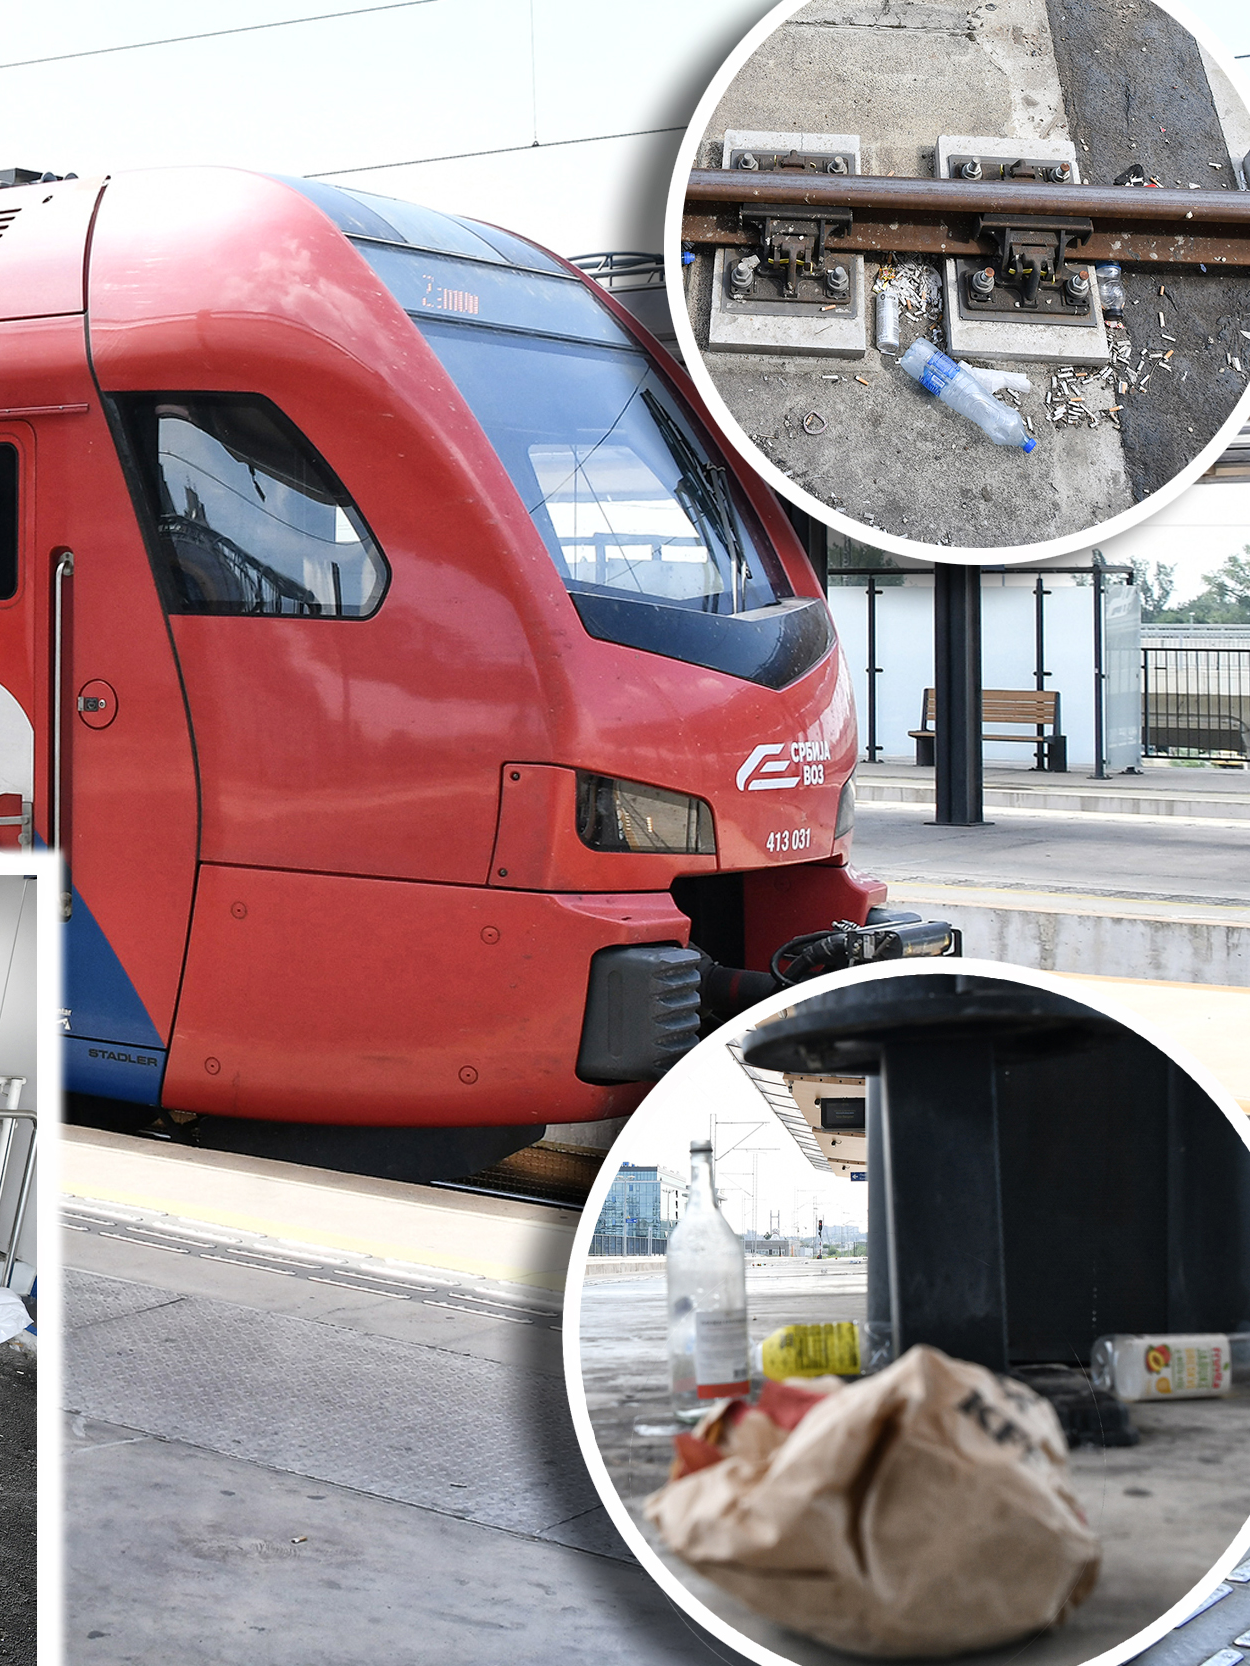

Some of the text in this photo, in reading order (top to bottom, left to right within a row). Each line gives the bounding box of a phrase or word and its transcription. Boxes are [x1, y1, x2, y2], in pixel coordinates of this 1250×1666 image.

[791, 741, 831, 763] СРБИЈА
[803, 763, 825, 786] ВОЗ
[766, 827, 811, 852] 413 031
[88, 1048, 158, 1067] STADLER
